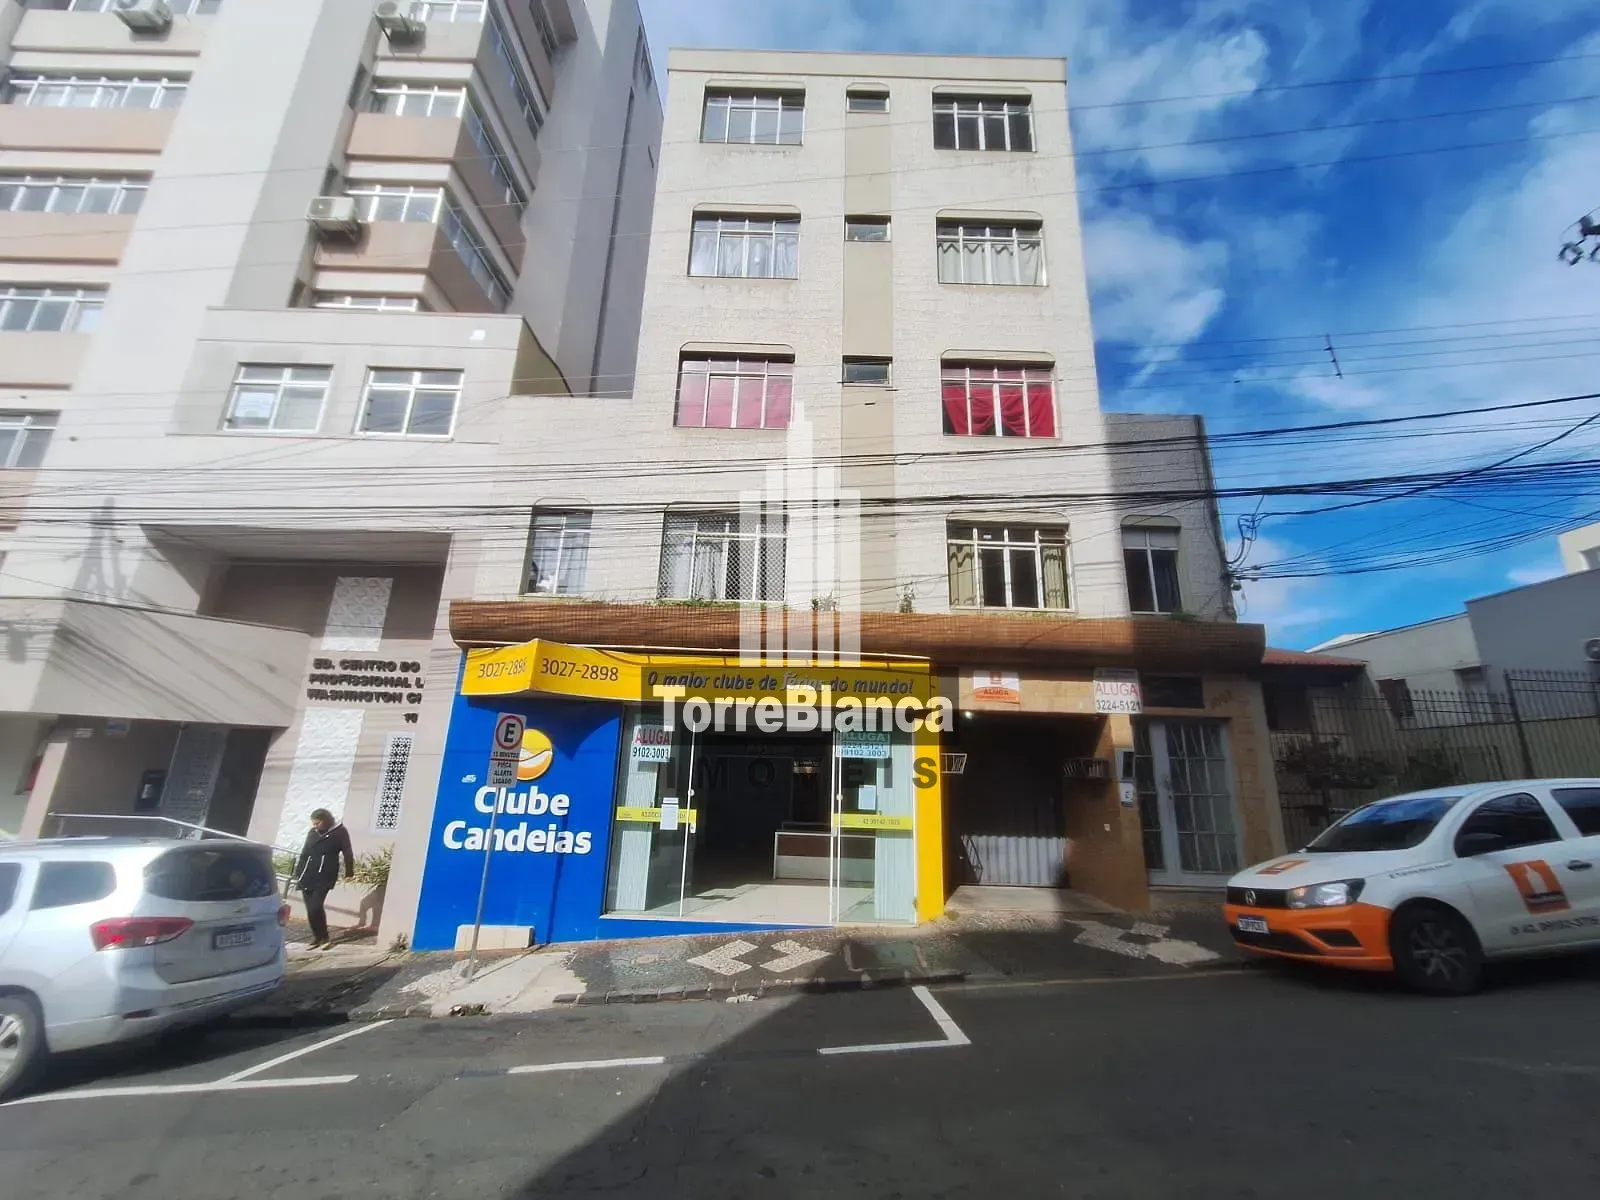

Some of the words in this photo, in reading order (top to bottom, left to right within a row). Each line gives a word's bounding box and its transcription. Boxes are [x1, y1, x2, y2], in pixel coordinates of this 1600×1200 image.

[339, 659, 397, 672] CENTRO
[540, 658, 619, 682] 3027-2898
[647, 671, 658, 686] O
[662, 672, 710, 688] maior
[713, 671, 754, 690] clube
[758, 674, 777, 690] de
[830, 676, 848, 692] do
[1096, 683, 1138, 696] ALUGA
[1096, 699, 1140, 712] 3224-5121
[504, 723, 516, 742] E
[635, 728, 670, 744] ALUGA
[474, 785, 570, 816] Clube
[443, 820, 592, 854] Candeias
